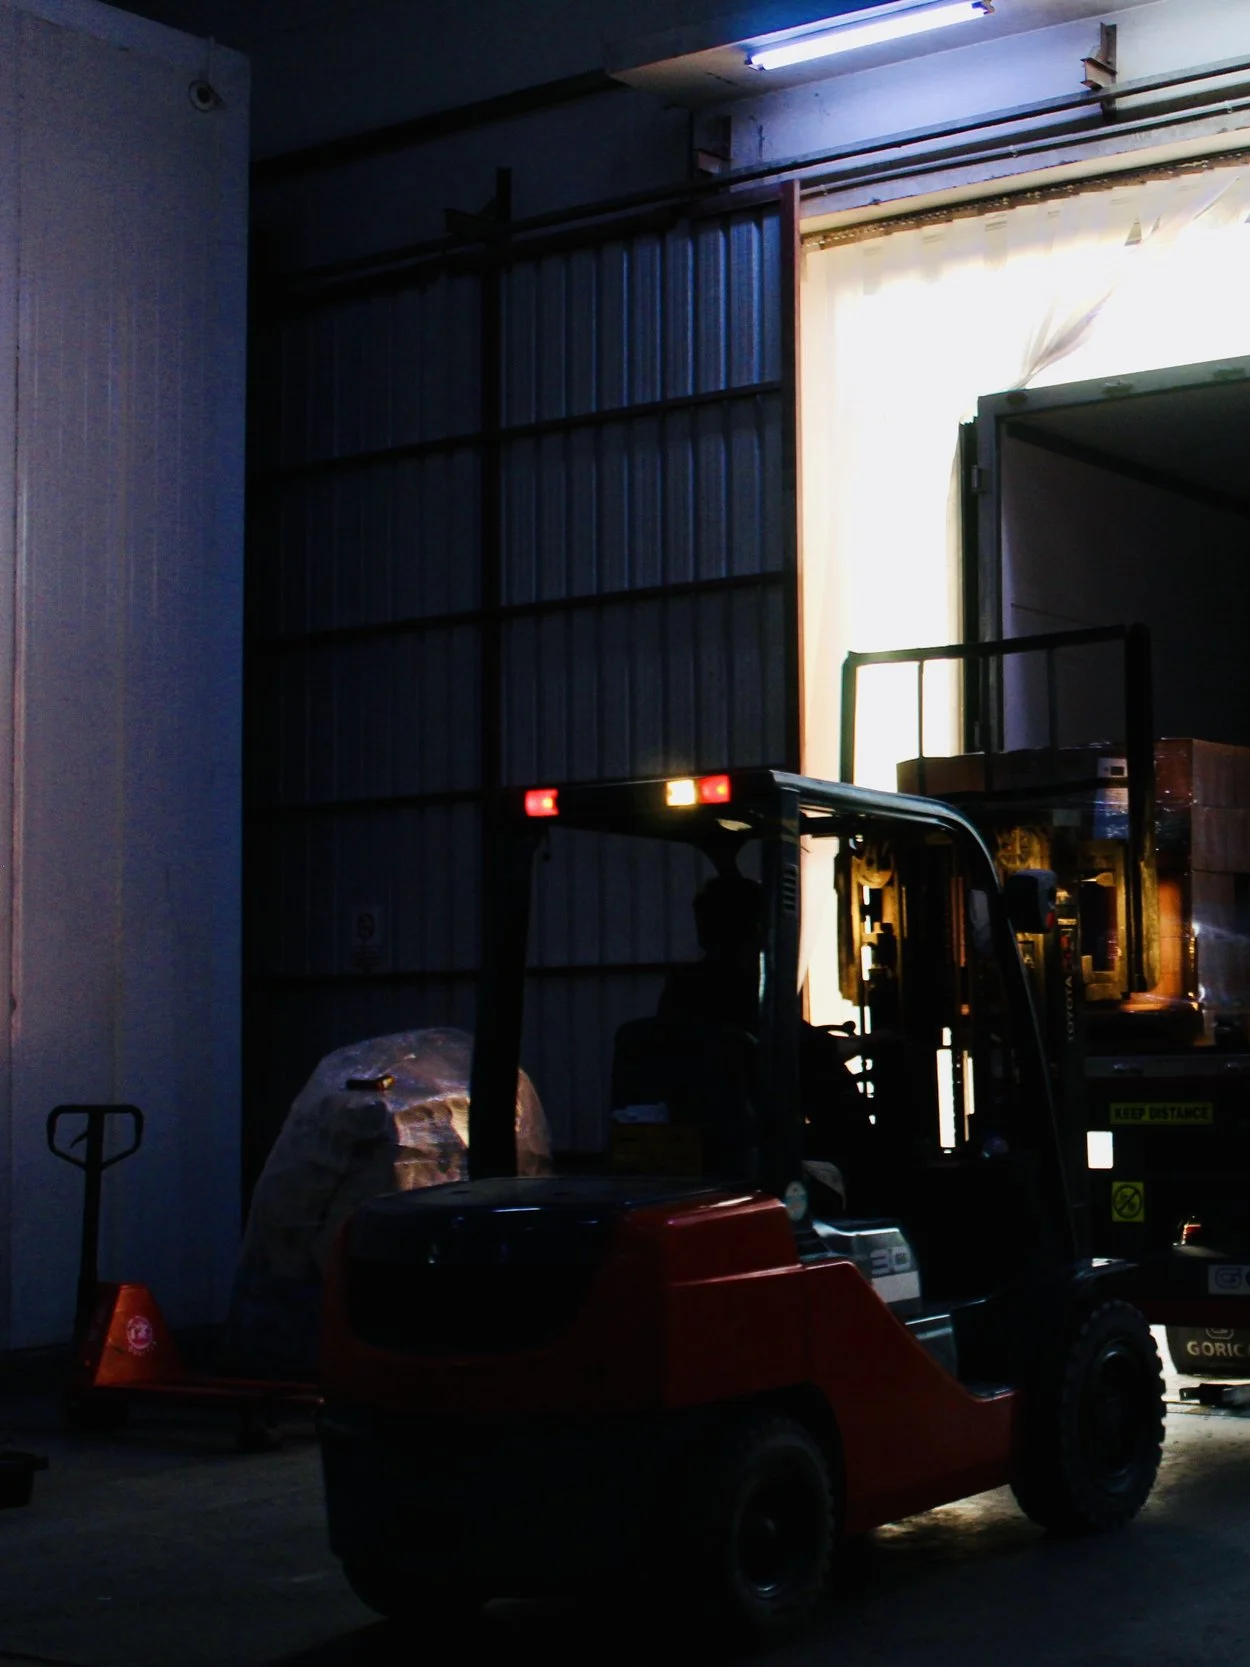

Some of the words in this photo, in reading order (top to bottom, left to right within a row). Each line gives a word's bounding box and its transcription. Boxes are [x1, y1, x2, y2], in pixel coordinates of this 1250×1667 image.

[1064, 976, 1074, 1042] TOYOTA
[1115, 1107, 1146, 1121] KEEP
[1148, 1106, 1209, 1120] DISTANCE
